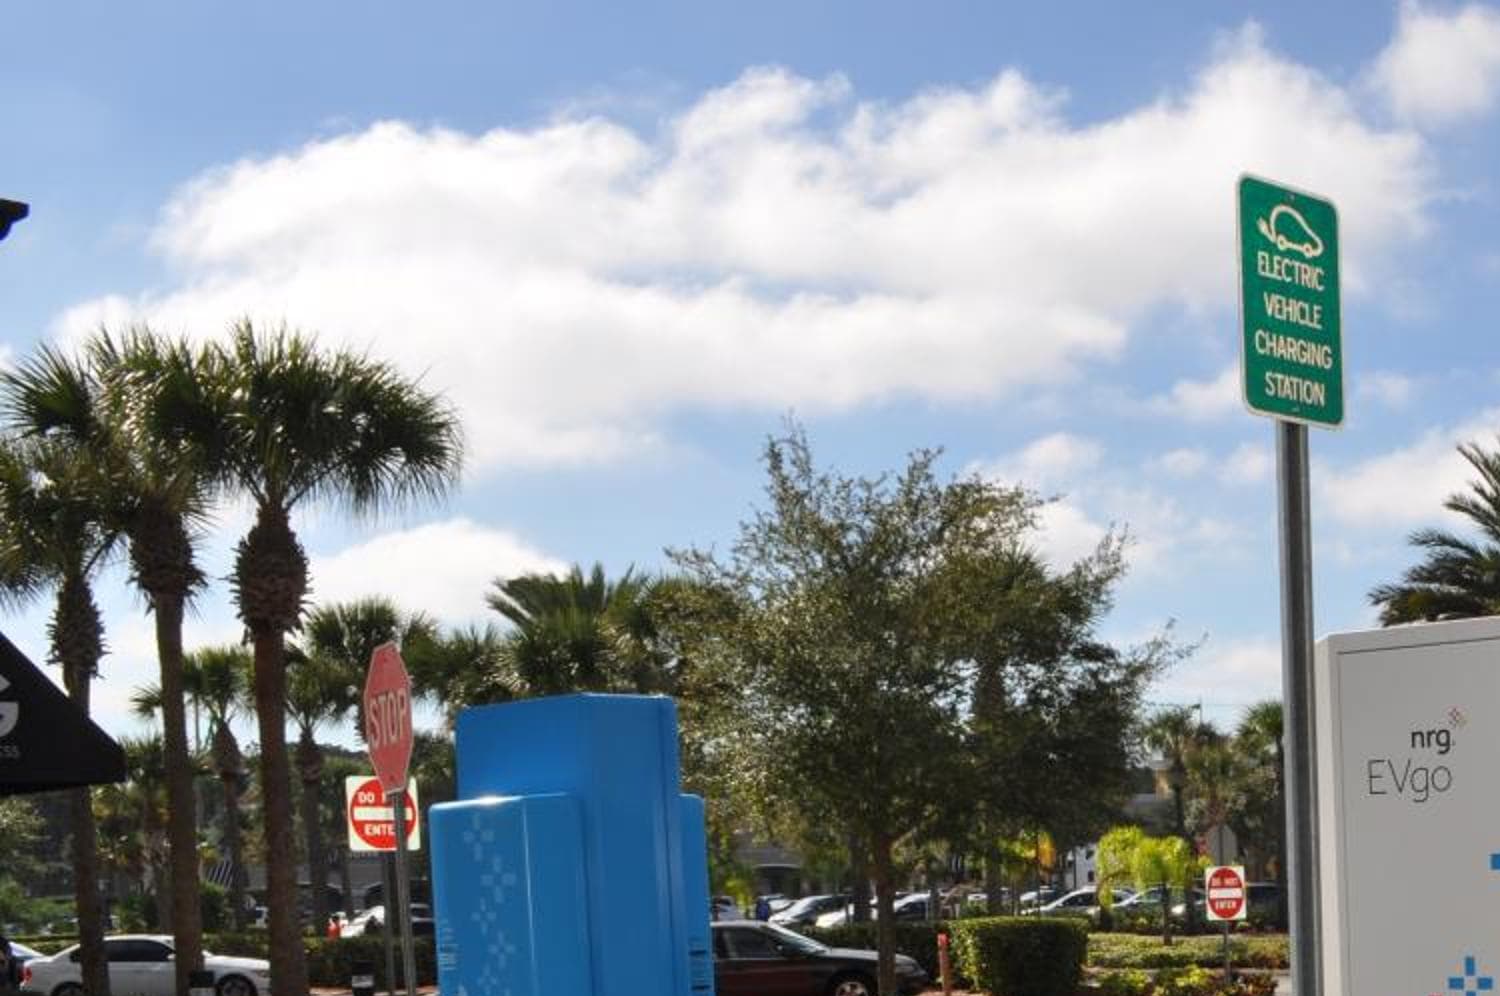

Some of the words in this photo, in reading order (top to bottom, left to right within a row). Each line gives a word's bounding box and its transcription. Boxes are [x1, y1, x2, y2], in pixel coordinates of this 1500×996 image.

[1257, 251, 1325, 291] ELECTRIC
[1263, 292, 1322, 329] VEHICLE
[1255, 330, 1332, 369] CHARGING
[1265, 372, 1325, 407] STATION
[369, 688, 408, 751] STOP
[1411, 729, 1451, 755] nrg
[358, 791, 376, 804] DO
[1367, 758, 1453, 803] EVgo
[364, 824, 397, 838] ENTE
